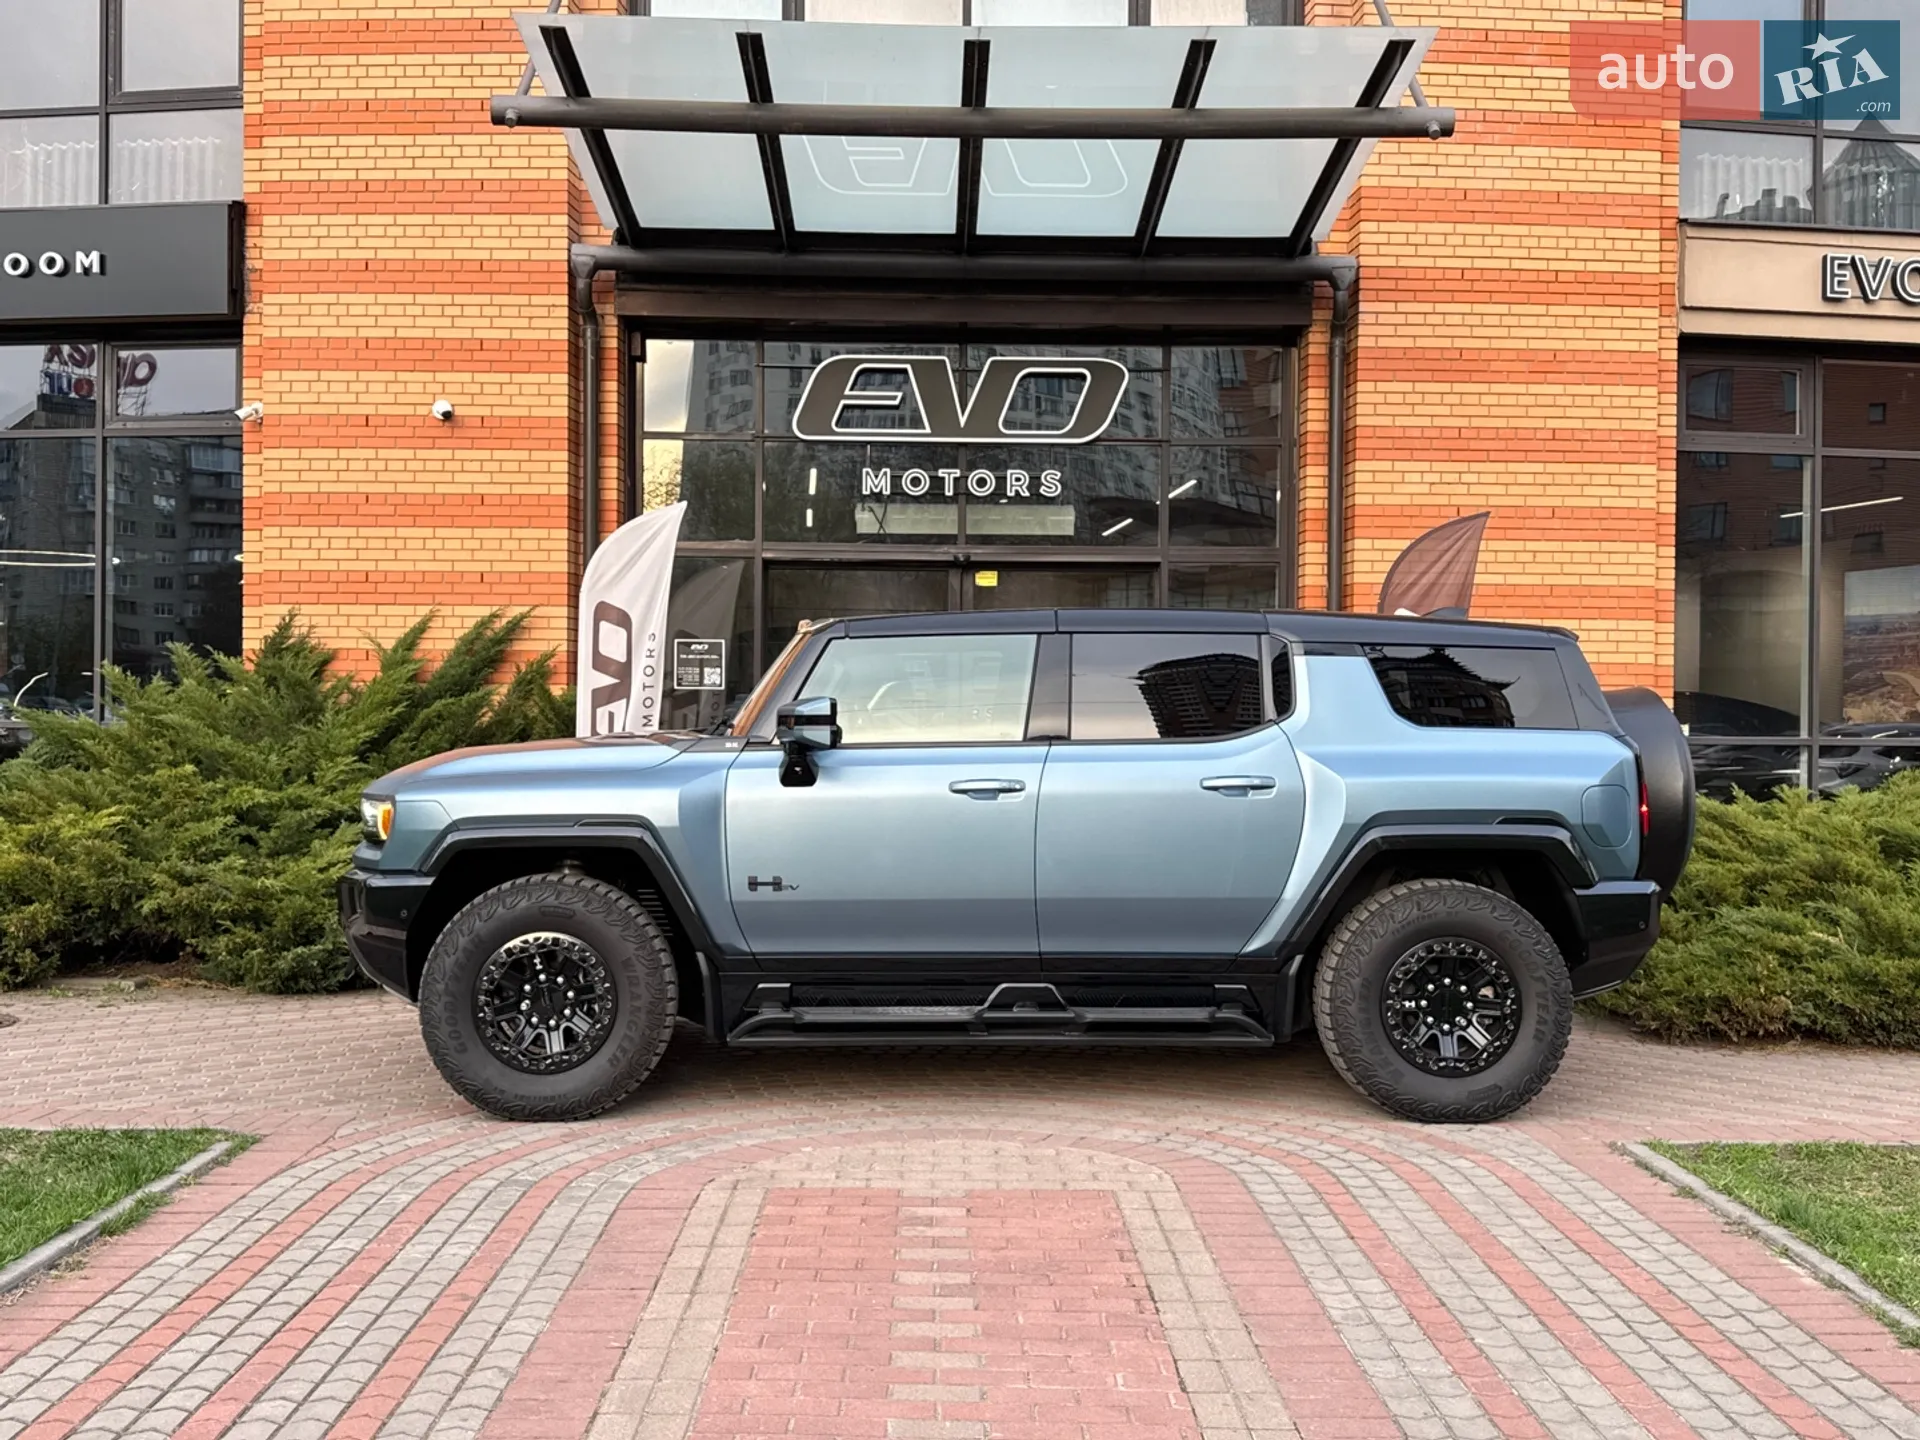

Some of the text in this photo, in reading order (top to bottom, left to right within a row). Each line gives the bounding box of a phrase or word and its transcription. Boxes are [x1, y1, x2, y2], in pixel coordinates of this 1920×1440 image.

[792, 354, 1129, 444] EVO
[861, 468, 1062, 497] MOTORS
[642, 632, 656, 727] MOTORS
